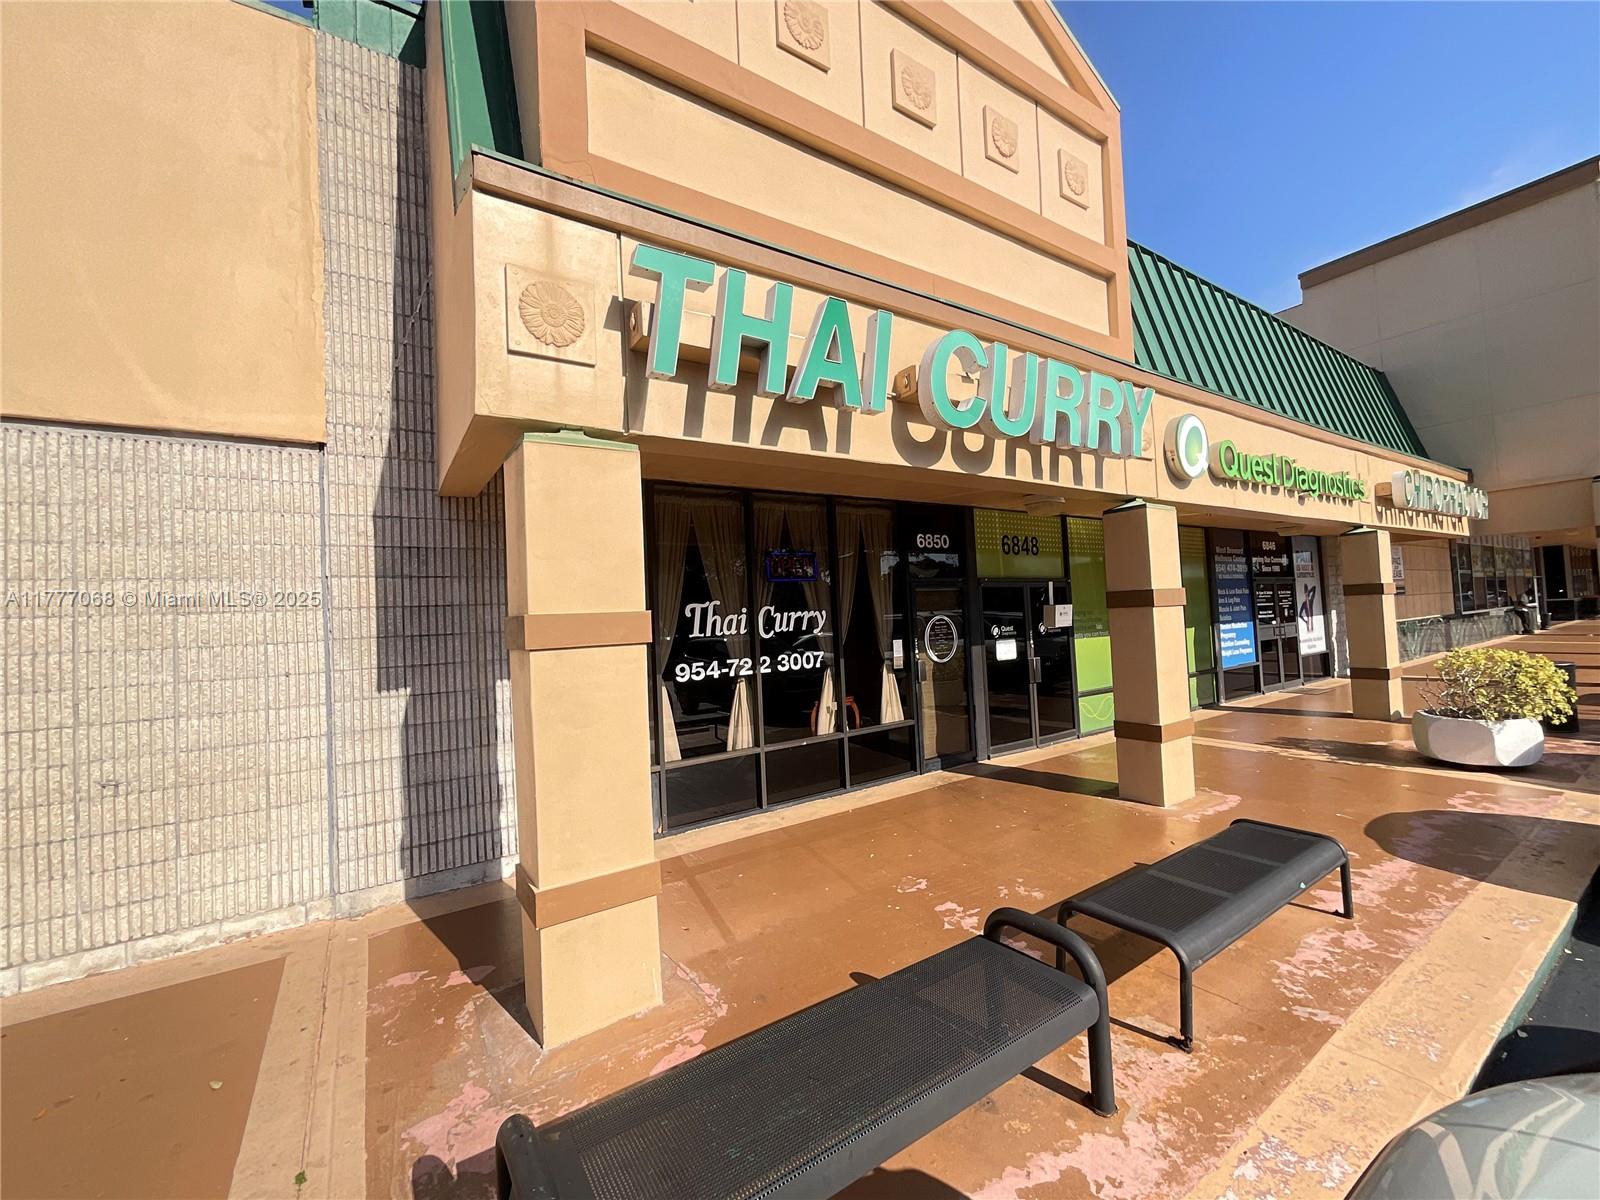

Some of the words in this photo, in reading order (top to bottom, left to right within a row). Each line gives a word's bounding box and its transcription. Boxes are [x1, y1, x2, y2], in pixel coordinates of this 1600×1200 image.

[631, 243, 894, 415] THAI
[920, 329, 1155, 459] CURRY
[1218, 439, 1281, 486] Quest
[1282, 455, 1368, 499] Diagnostics
[916, 533, 950, 549] 6850
[1001, 535, 1039, 556] 6848
[685, 600, 747, 638] Thai
[758, 605, 827, 639] Curry
[777, 651, 825, 672] 3007
